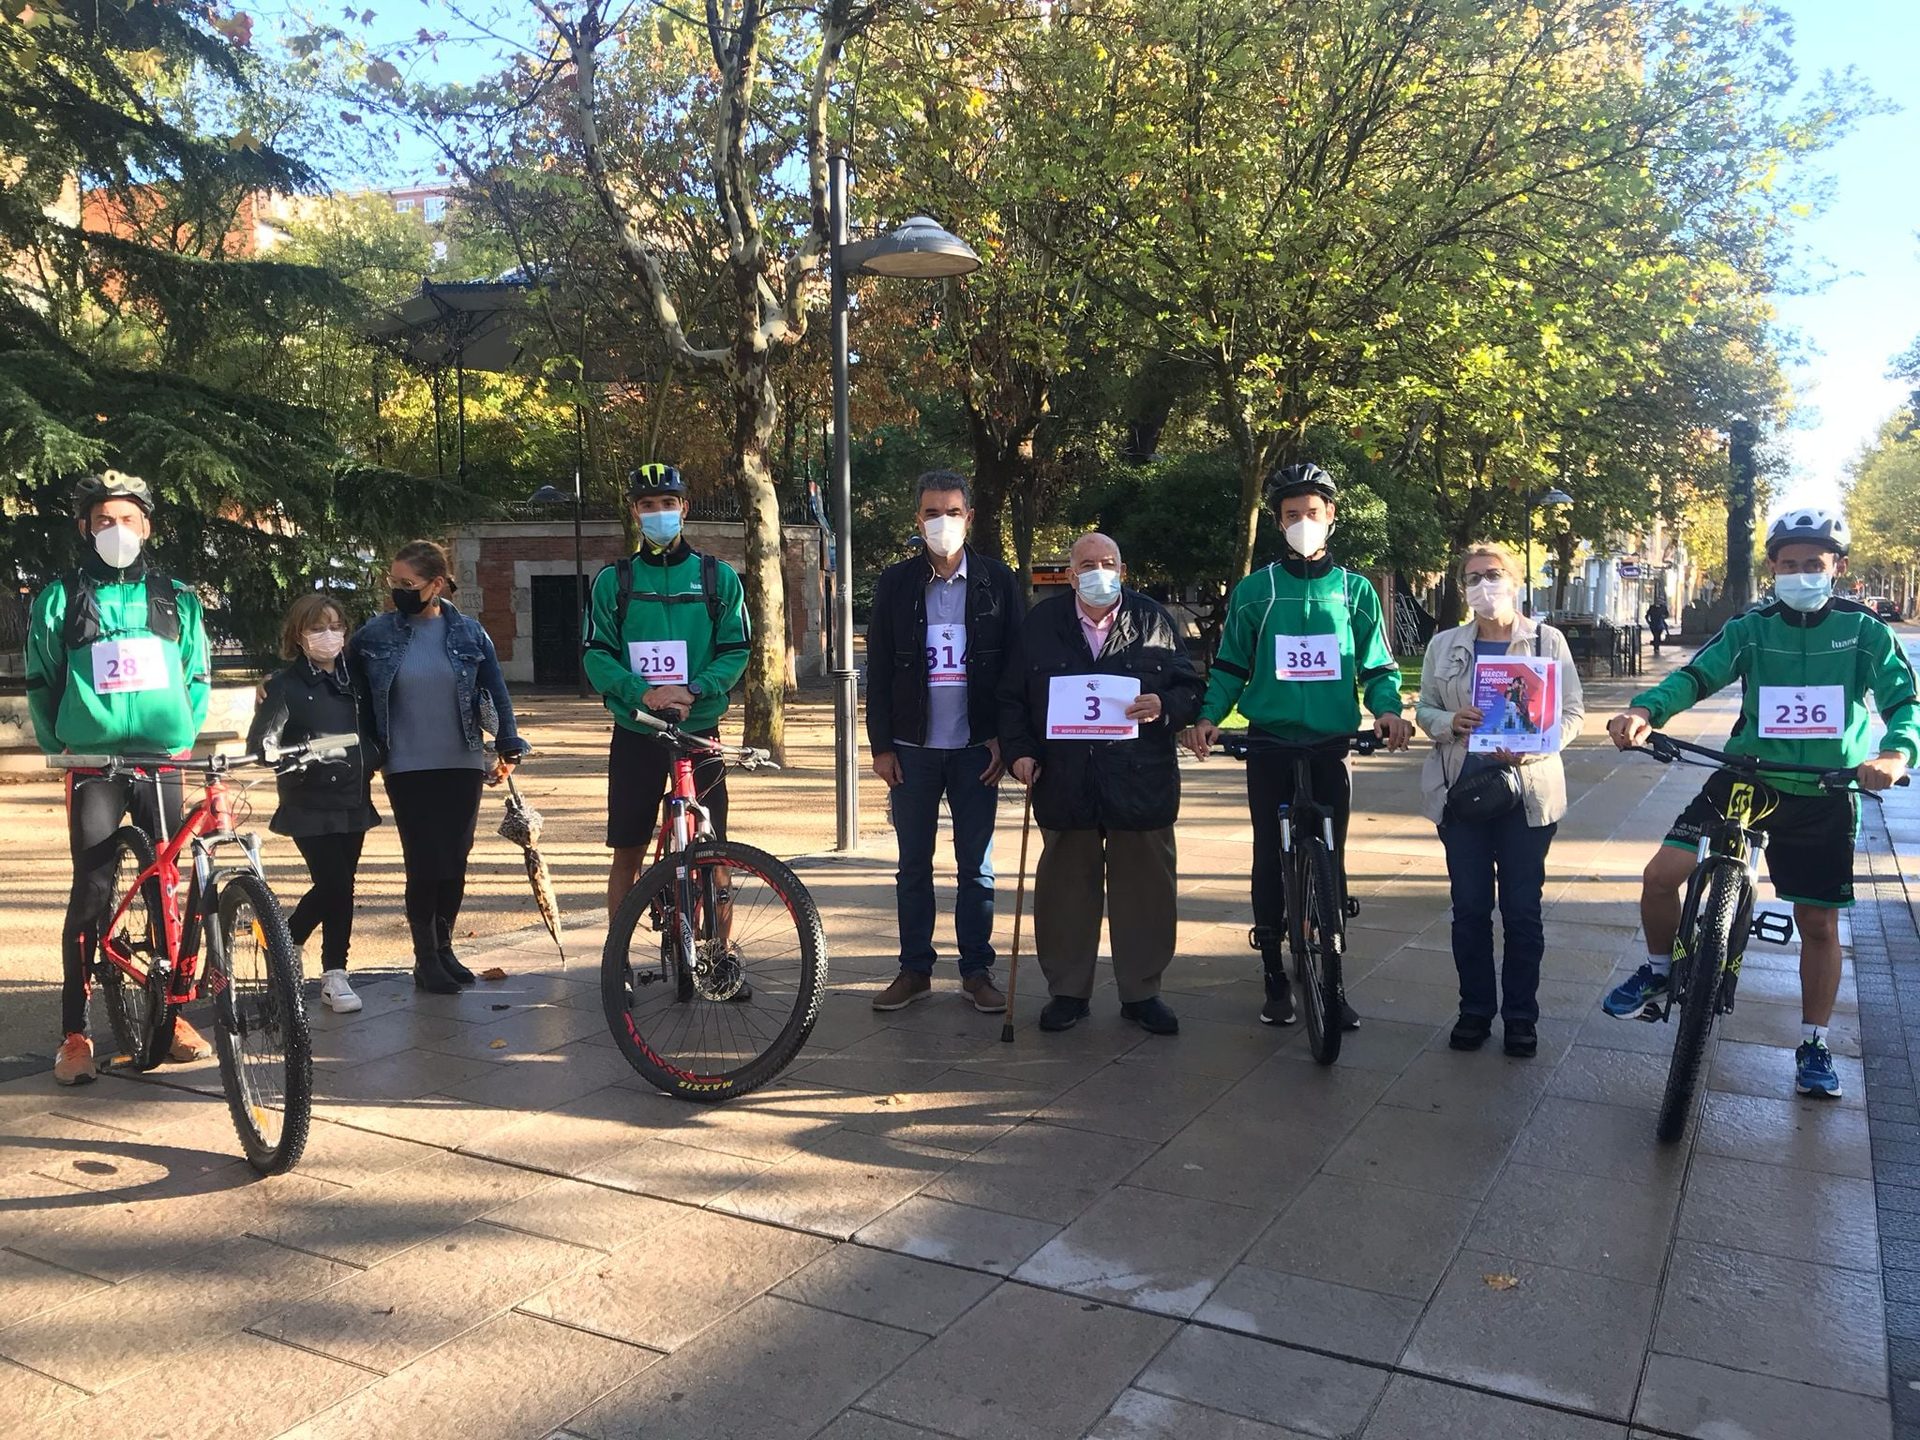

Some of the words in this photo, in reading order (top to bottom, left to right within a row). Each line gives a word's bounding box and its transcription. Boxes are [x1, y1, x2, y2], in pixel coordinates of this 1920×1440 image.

[639, 656, 676, 673] 219
[1286, 651, 1327, 669] 384
[1084, 696, 1101, 721] 3
[1775, 704, 1827, 724] 236
[678, 1080, 734, 1092] MAXXIS
